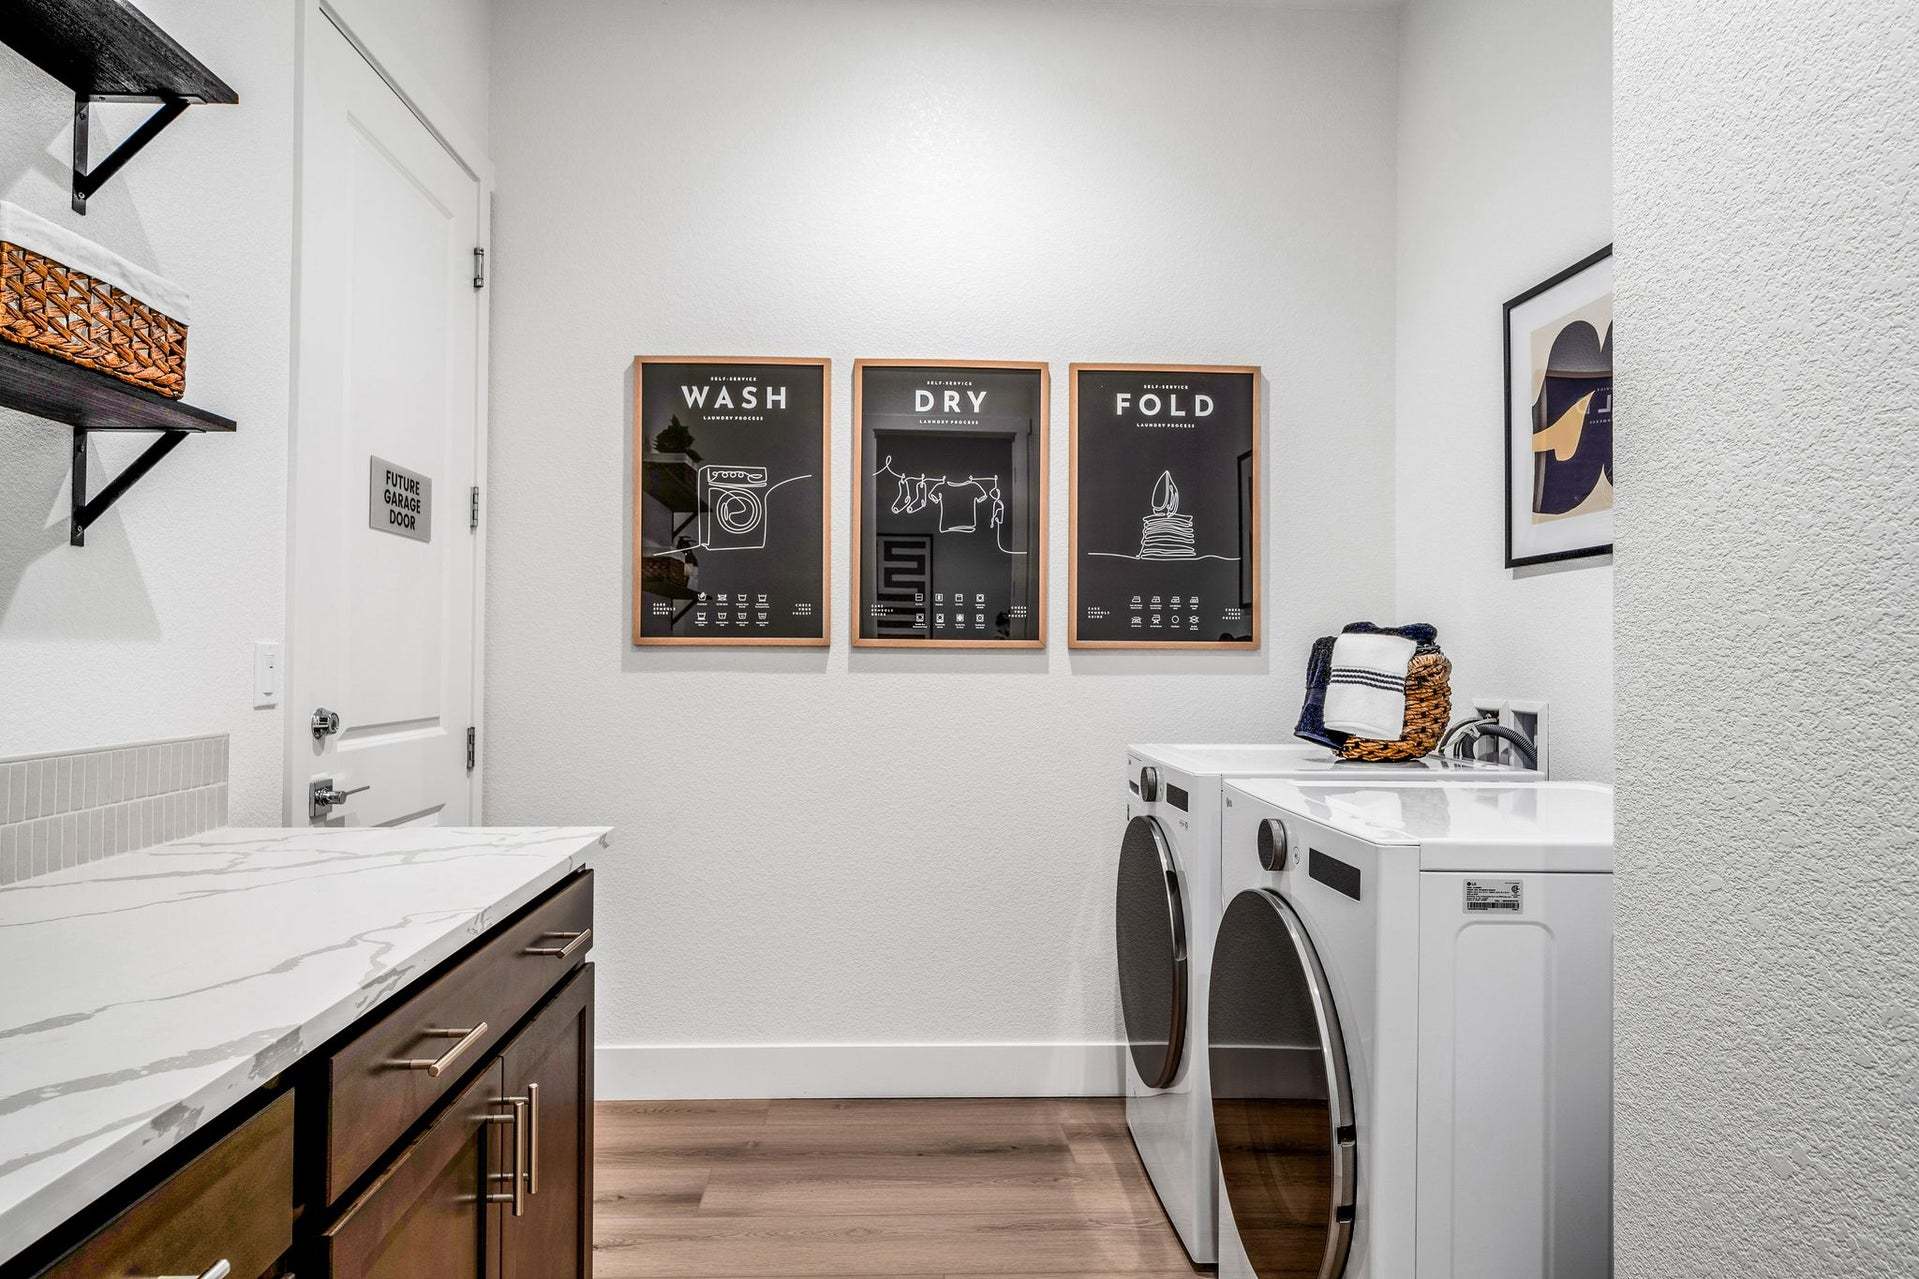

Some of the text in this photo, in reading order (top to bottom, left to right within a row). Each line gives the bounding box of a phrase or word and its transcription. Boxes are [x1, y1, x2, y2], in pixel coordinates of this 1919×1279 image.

[681, 385, 786, 409] WASH
[915, 389, 987, 413] DRY
[1116, 393, 1214, 417] FOLD
[386, 470, 420, 496] FUTURE
[384, 489, 421, 514] GARAGE
[390, 509, 416, 531] DOOR
